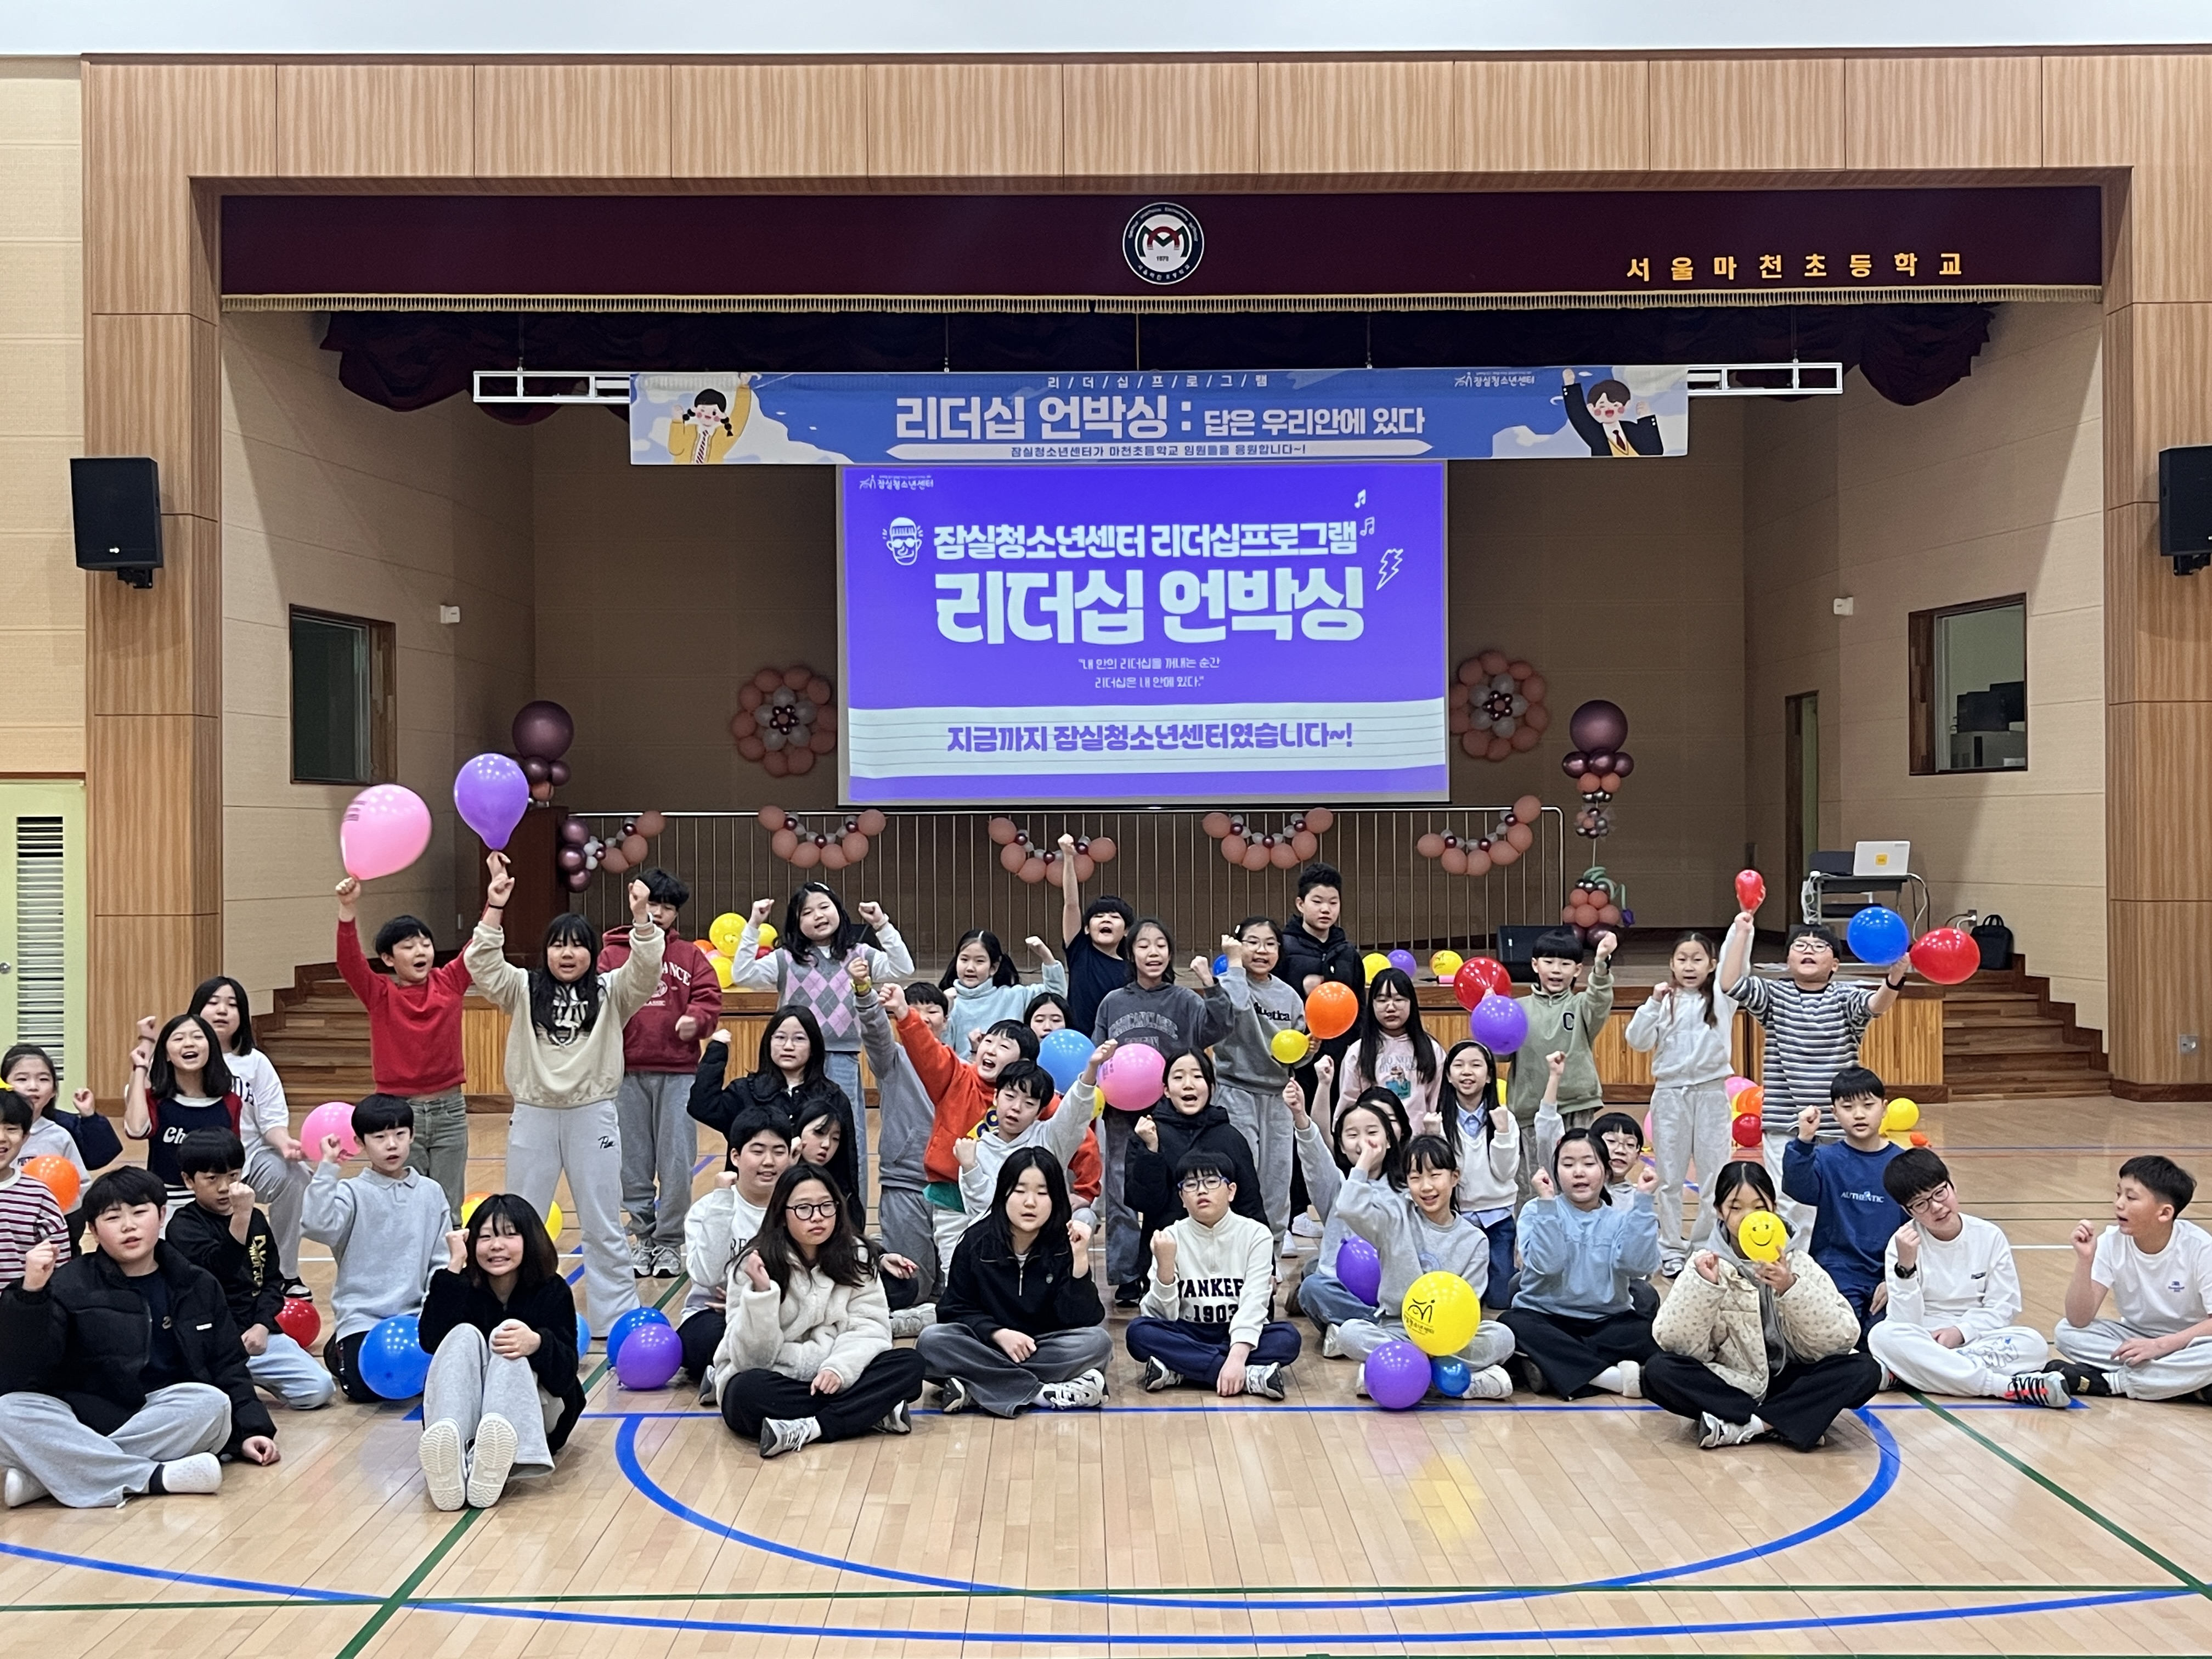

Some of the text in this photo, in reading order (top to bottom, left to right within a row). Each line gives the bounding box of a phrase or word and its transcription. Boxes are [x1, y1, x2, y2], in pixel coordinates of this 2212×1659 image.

[896, 396, 1025, 439] 리더십
[1039, 396, 1167, 439] 언박싱
[1204, 410, 1255, 436] 답은
[1262, 408, 1365, 435] 우리안에
[1373, 407, 1425, 434] 있다
[1011, 446, 1104, 457] 잠실청소년센터가
[1109, 445, 1178, 456] 마천초등학교
[934, 521, 1357, 560] 잠실청소년센터 리더십프로그램
[935, 567, 1364, 645] 리더십 언박싱
[1120, 658, 1161, 669] 리더십을
[1165, 657, 1197, 669] 꺼내는
[1199, 657, 1221, 668] 순간
[1095, 677, 1137, 689] 리더십은
[1153, 676, 1174, 688] 안에
[947, 722, 1353, 752] 지금까지 잠실청소년센터였습니다~!
[1562, 1012, 1575, 1031] C
